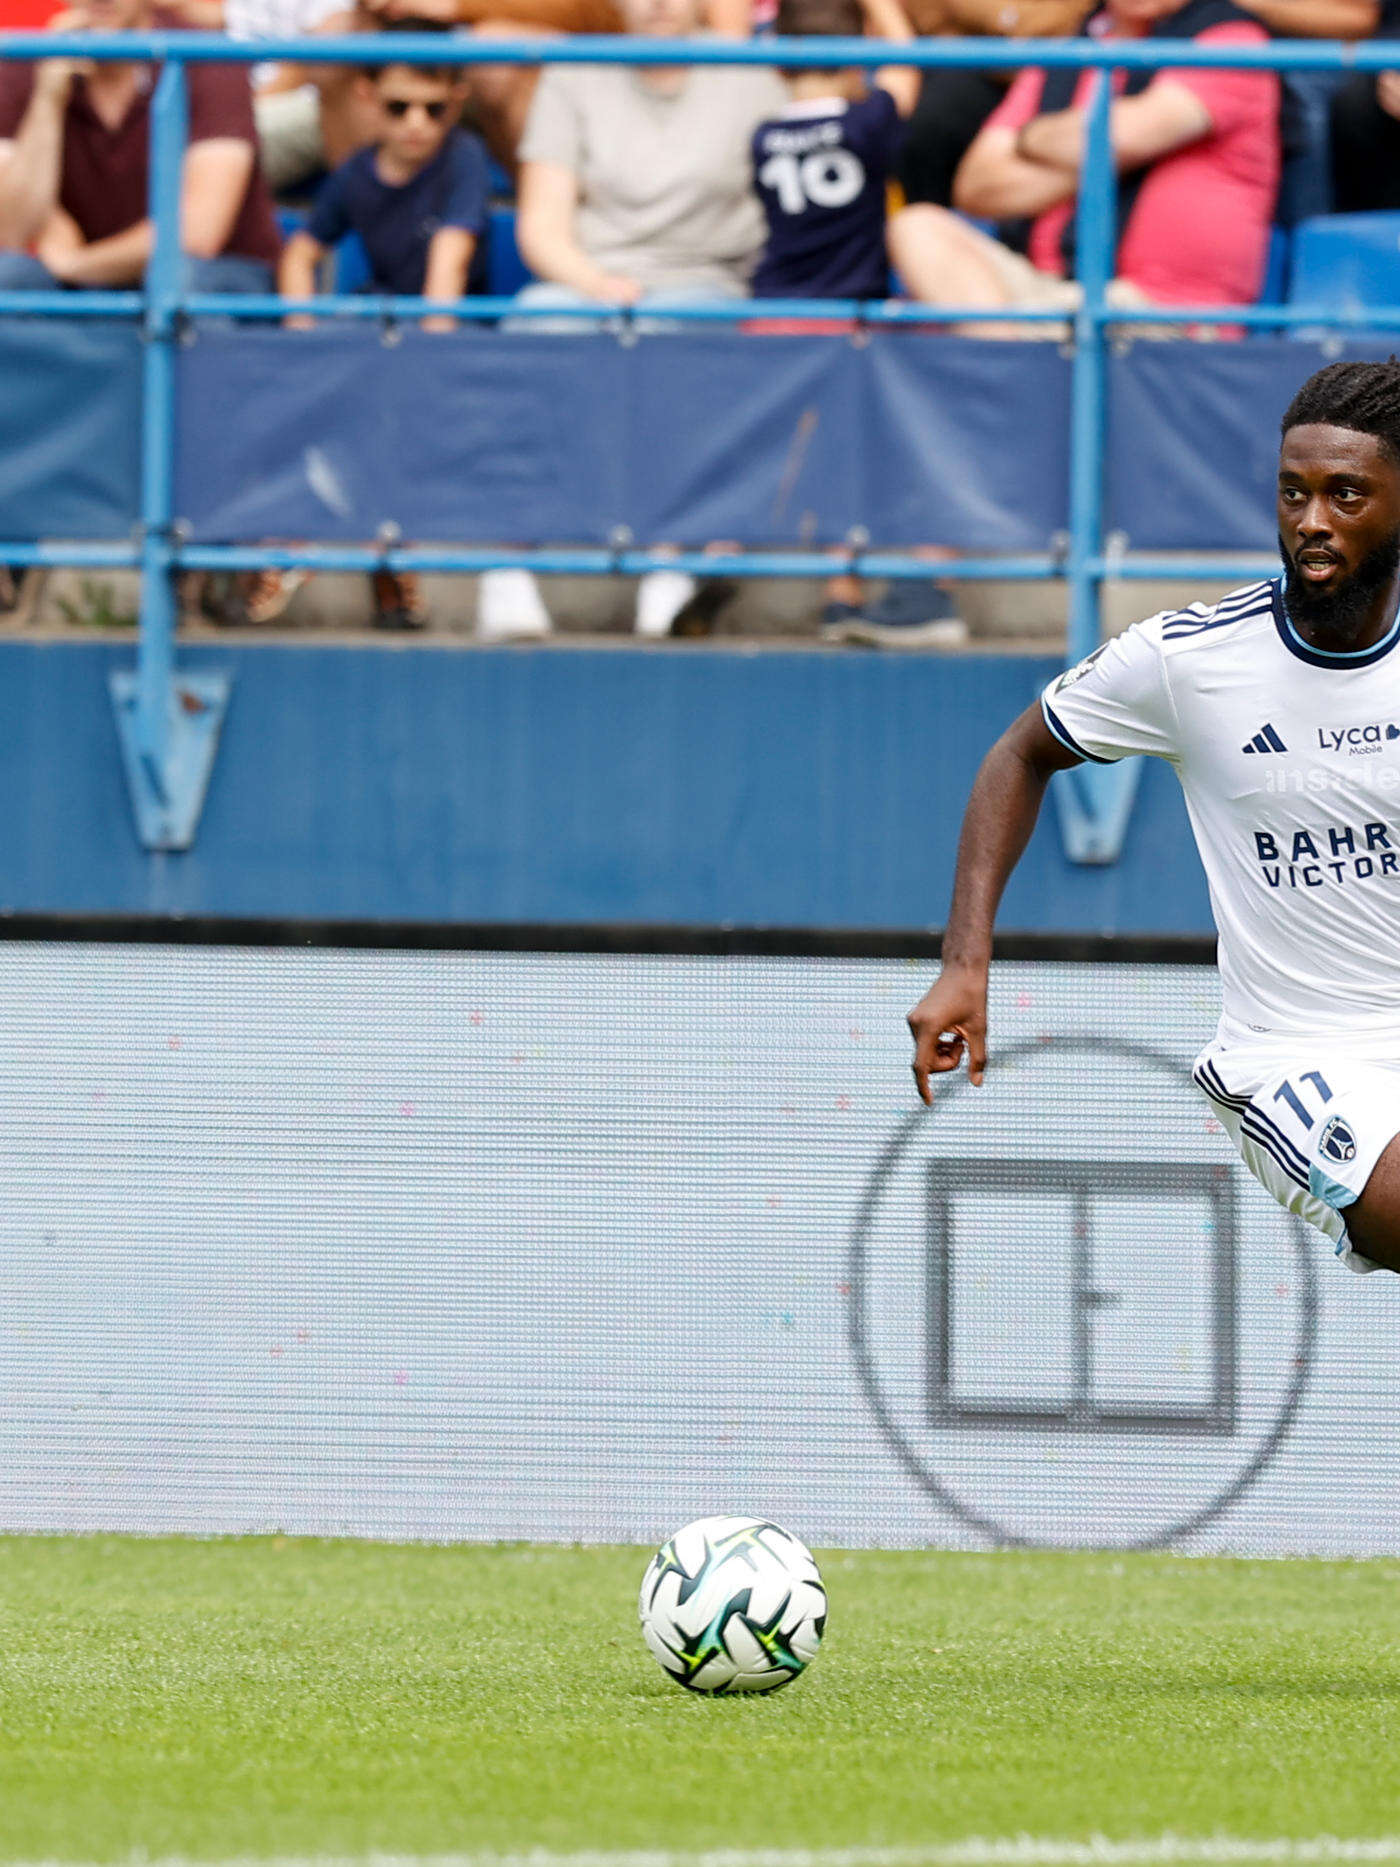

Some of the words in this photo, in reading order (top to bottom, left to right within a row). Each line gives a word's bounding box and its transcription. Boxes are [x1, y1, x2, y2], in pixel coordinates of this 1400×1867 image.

[759, 151, 865, 214] 10
[1318, 725, 1381, 752] Lyca
[1349, 745, 1383, 757] Mobile
[1272, 1070, 1334, 1132] 11
